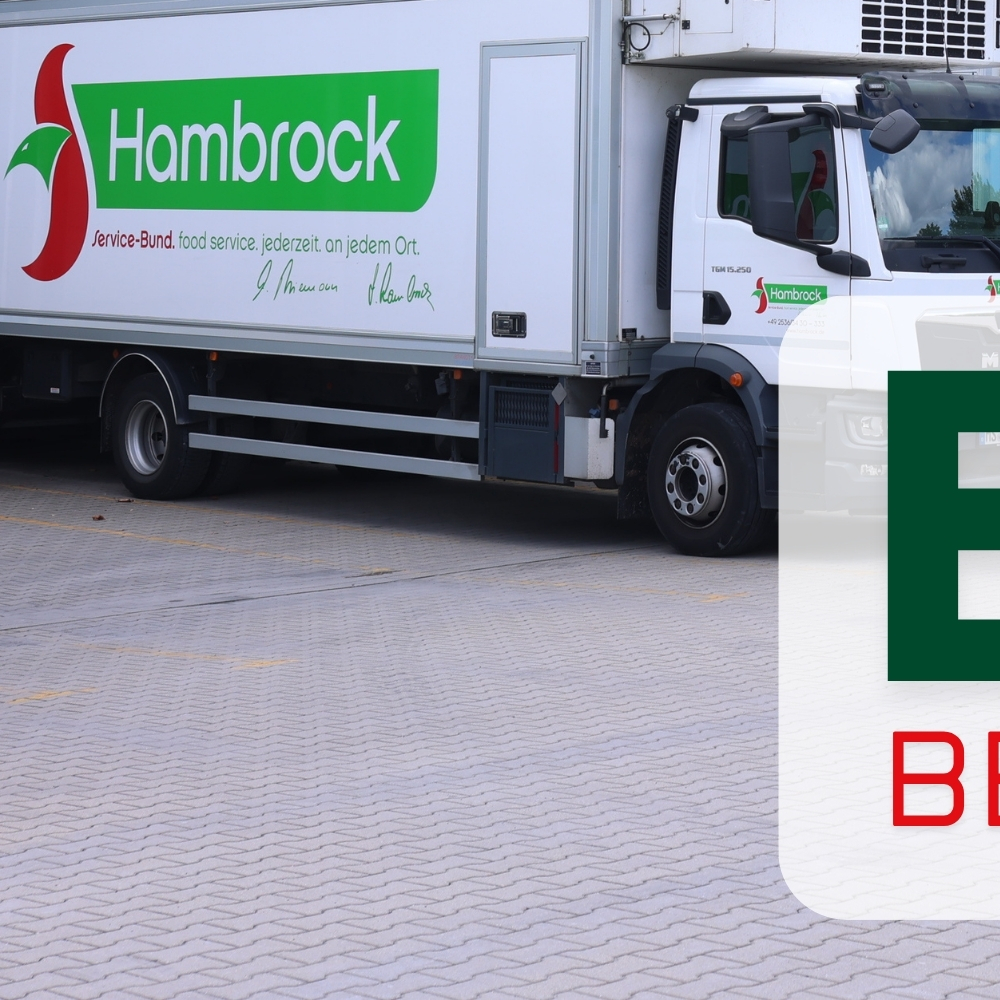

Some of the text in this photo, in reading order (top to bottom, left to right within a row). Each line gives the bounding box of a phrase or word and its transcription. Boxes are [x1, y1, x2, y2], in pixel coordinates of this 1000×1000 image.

[108, 95, 401, 183] Hambrock
[91, 229, 420, 259] Service-Bund. food service. jederzeit. an jedem Ort.
[727, 266, 752, 274] 15.250
[770, 287, 822, 302] Hambrock
